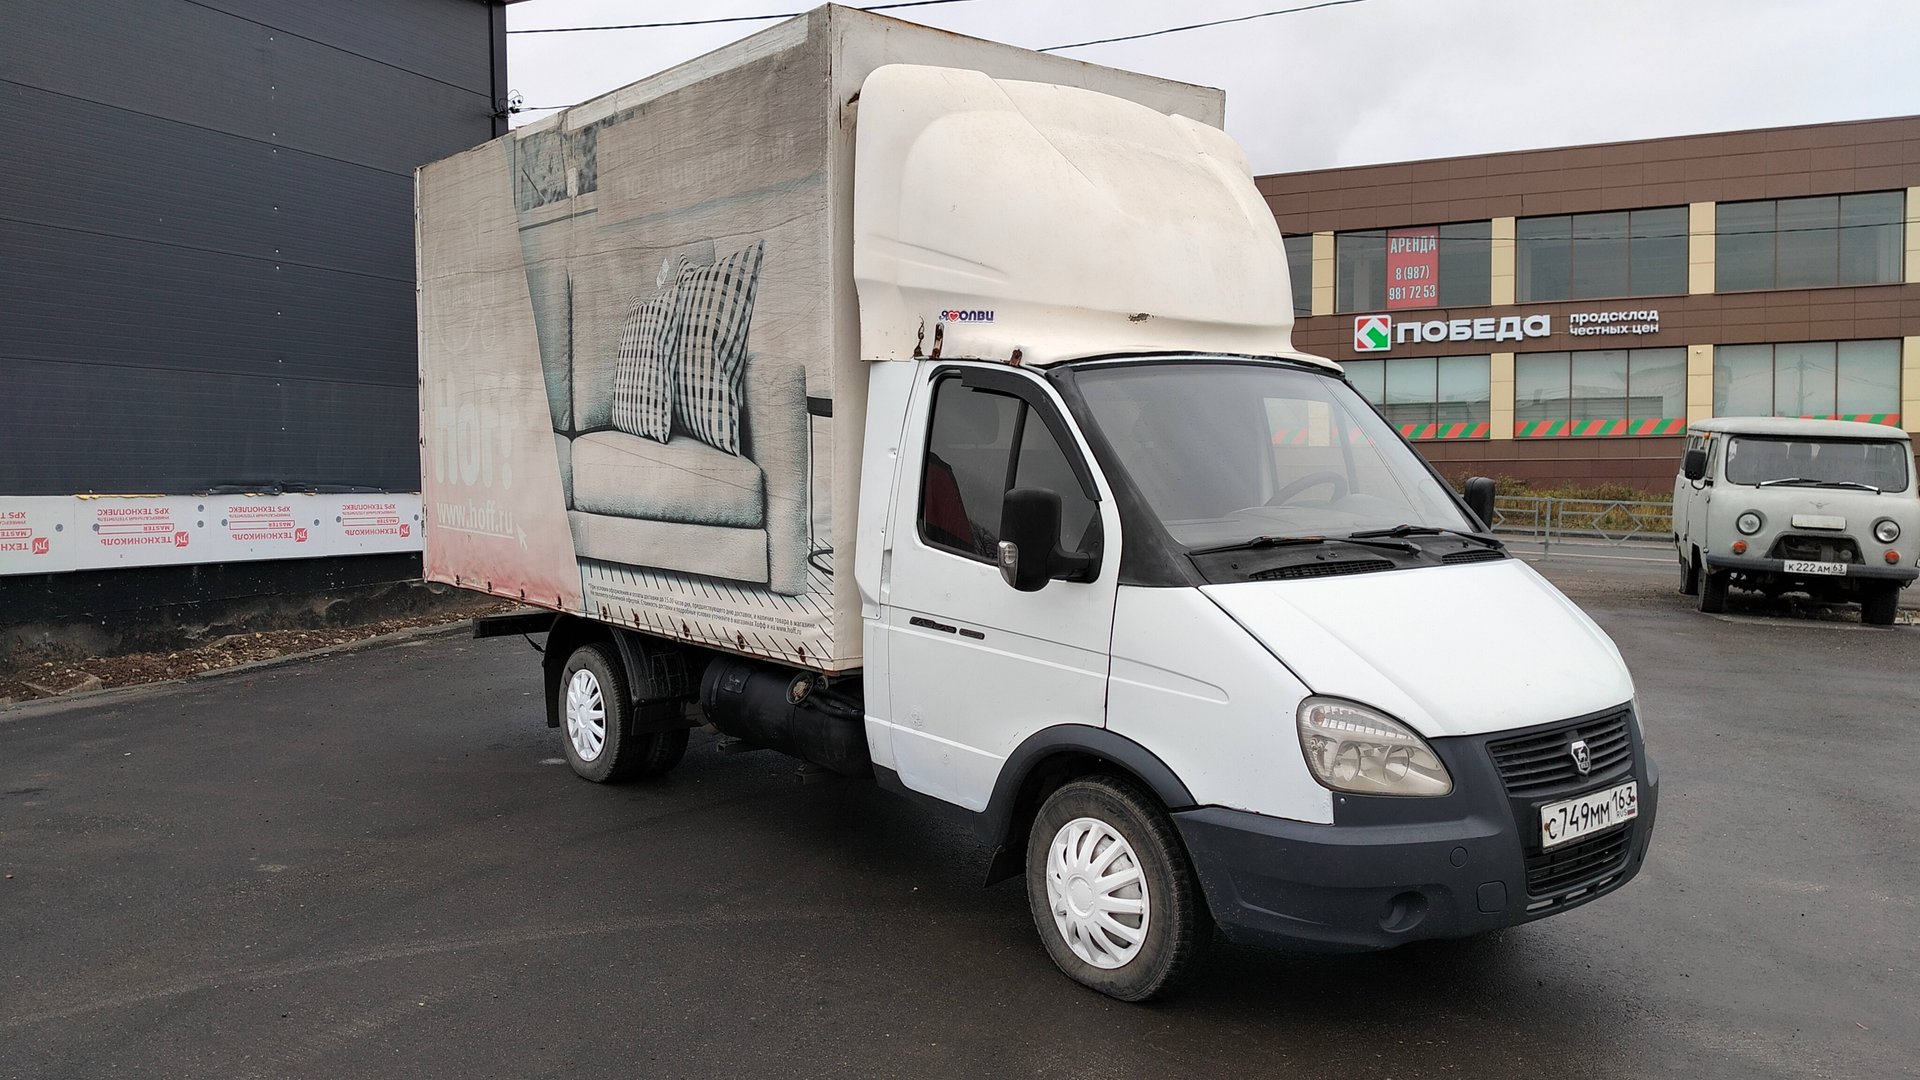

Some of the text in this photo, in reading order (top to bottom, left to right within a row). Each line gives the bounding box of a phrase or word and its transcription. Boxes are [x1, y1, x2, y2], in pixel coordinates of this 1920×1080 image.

[1390, 234, 1436, 255] АРЕНДА
[1395, 264, 1430, 281] 8 (987)
[1388, 285, 1436, 301] 981 72 53
[1570, 309, 1659, 326] продсклад
[1396, 314, 1551, 344] ПОБЕДА
[1570, 322, 1659, 337] честных цен
[437, 499, 513, 534] www.hoff.ru
[100, 536, 171, 546] ТЕХНОНИКОЛЬ
[232, 532, 292, 541] ТЕХНОНИКОЛЬ
[1833, 564, 1843, 572] 63
[1612, 787, 1632, 811] 163
